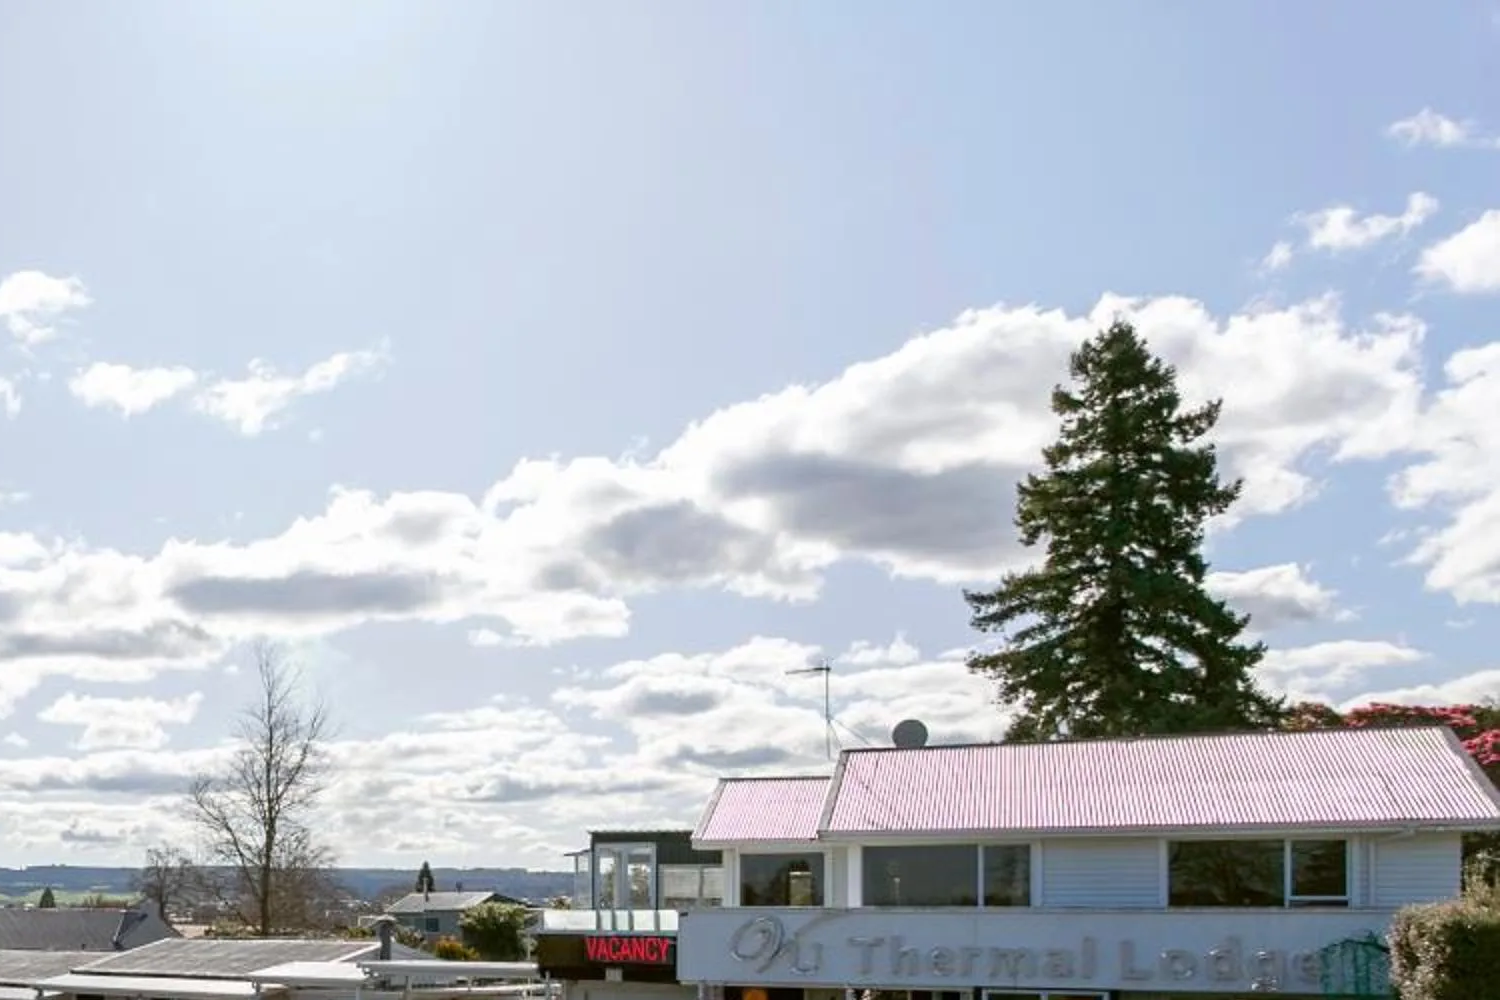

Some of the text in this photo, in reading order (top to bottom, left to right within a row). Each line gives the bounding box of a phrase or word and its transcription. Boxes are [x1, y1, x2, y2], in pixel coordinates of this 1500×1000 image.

[585, 936, 670, 961] VACANCY
[846, 934, 1096, 980] Thermal
[1118, 935, 1322, 992] Lodge
